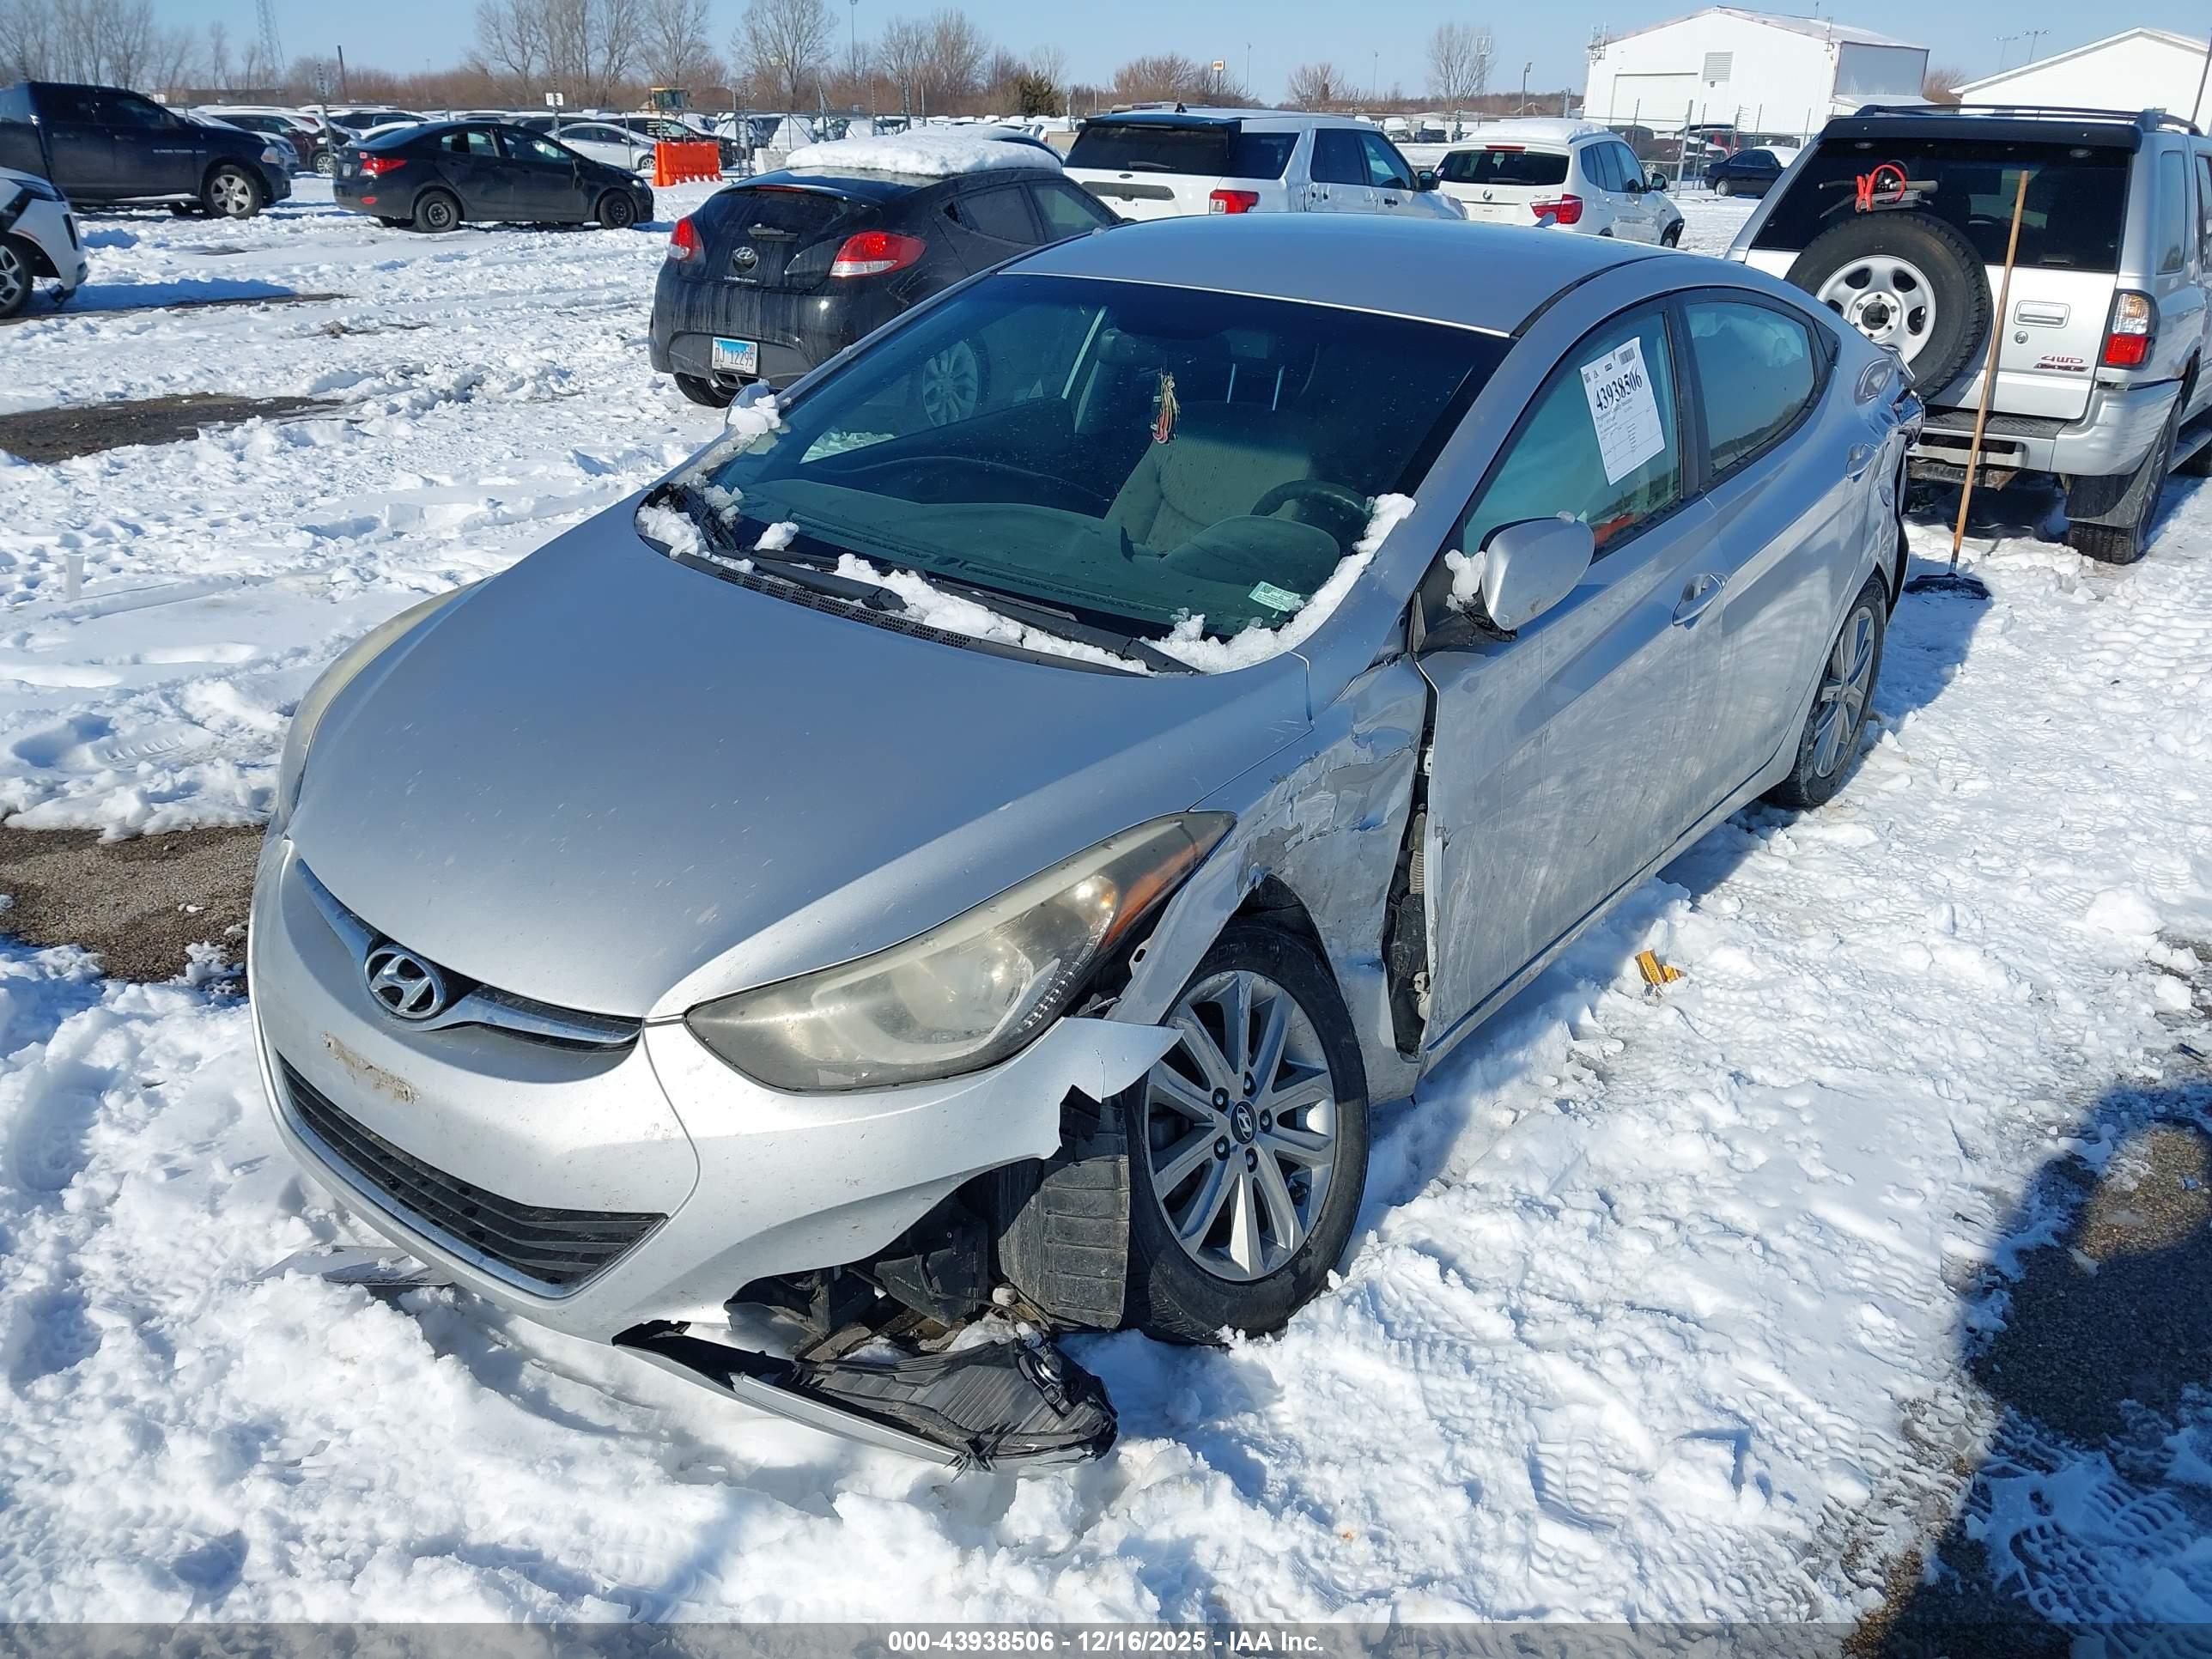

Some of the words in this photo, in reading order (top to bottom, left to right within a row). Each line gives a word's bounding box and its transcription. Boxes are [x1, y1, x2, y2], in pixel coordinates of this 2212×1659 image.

[730, 349, 754, 368] 12295
[2040, 356, 2084, 364] 4WD
[1595, 366, 1643, 411] 43938506
